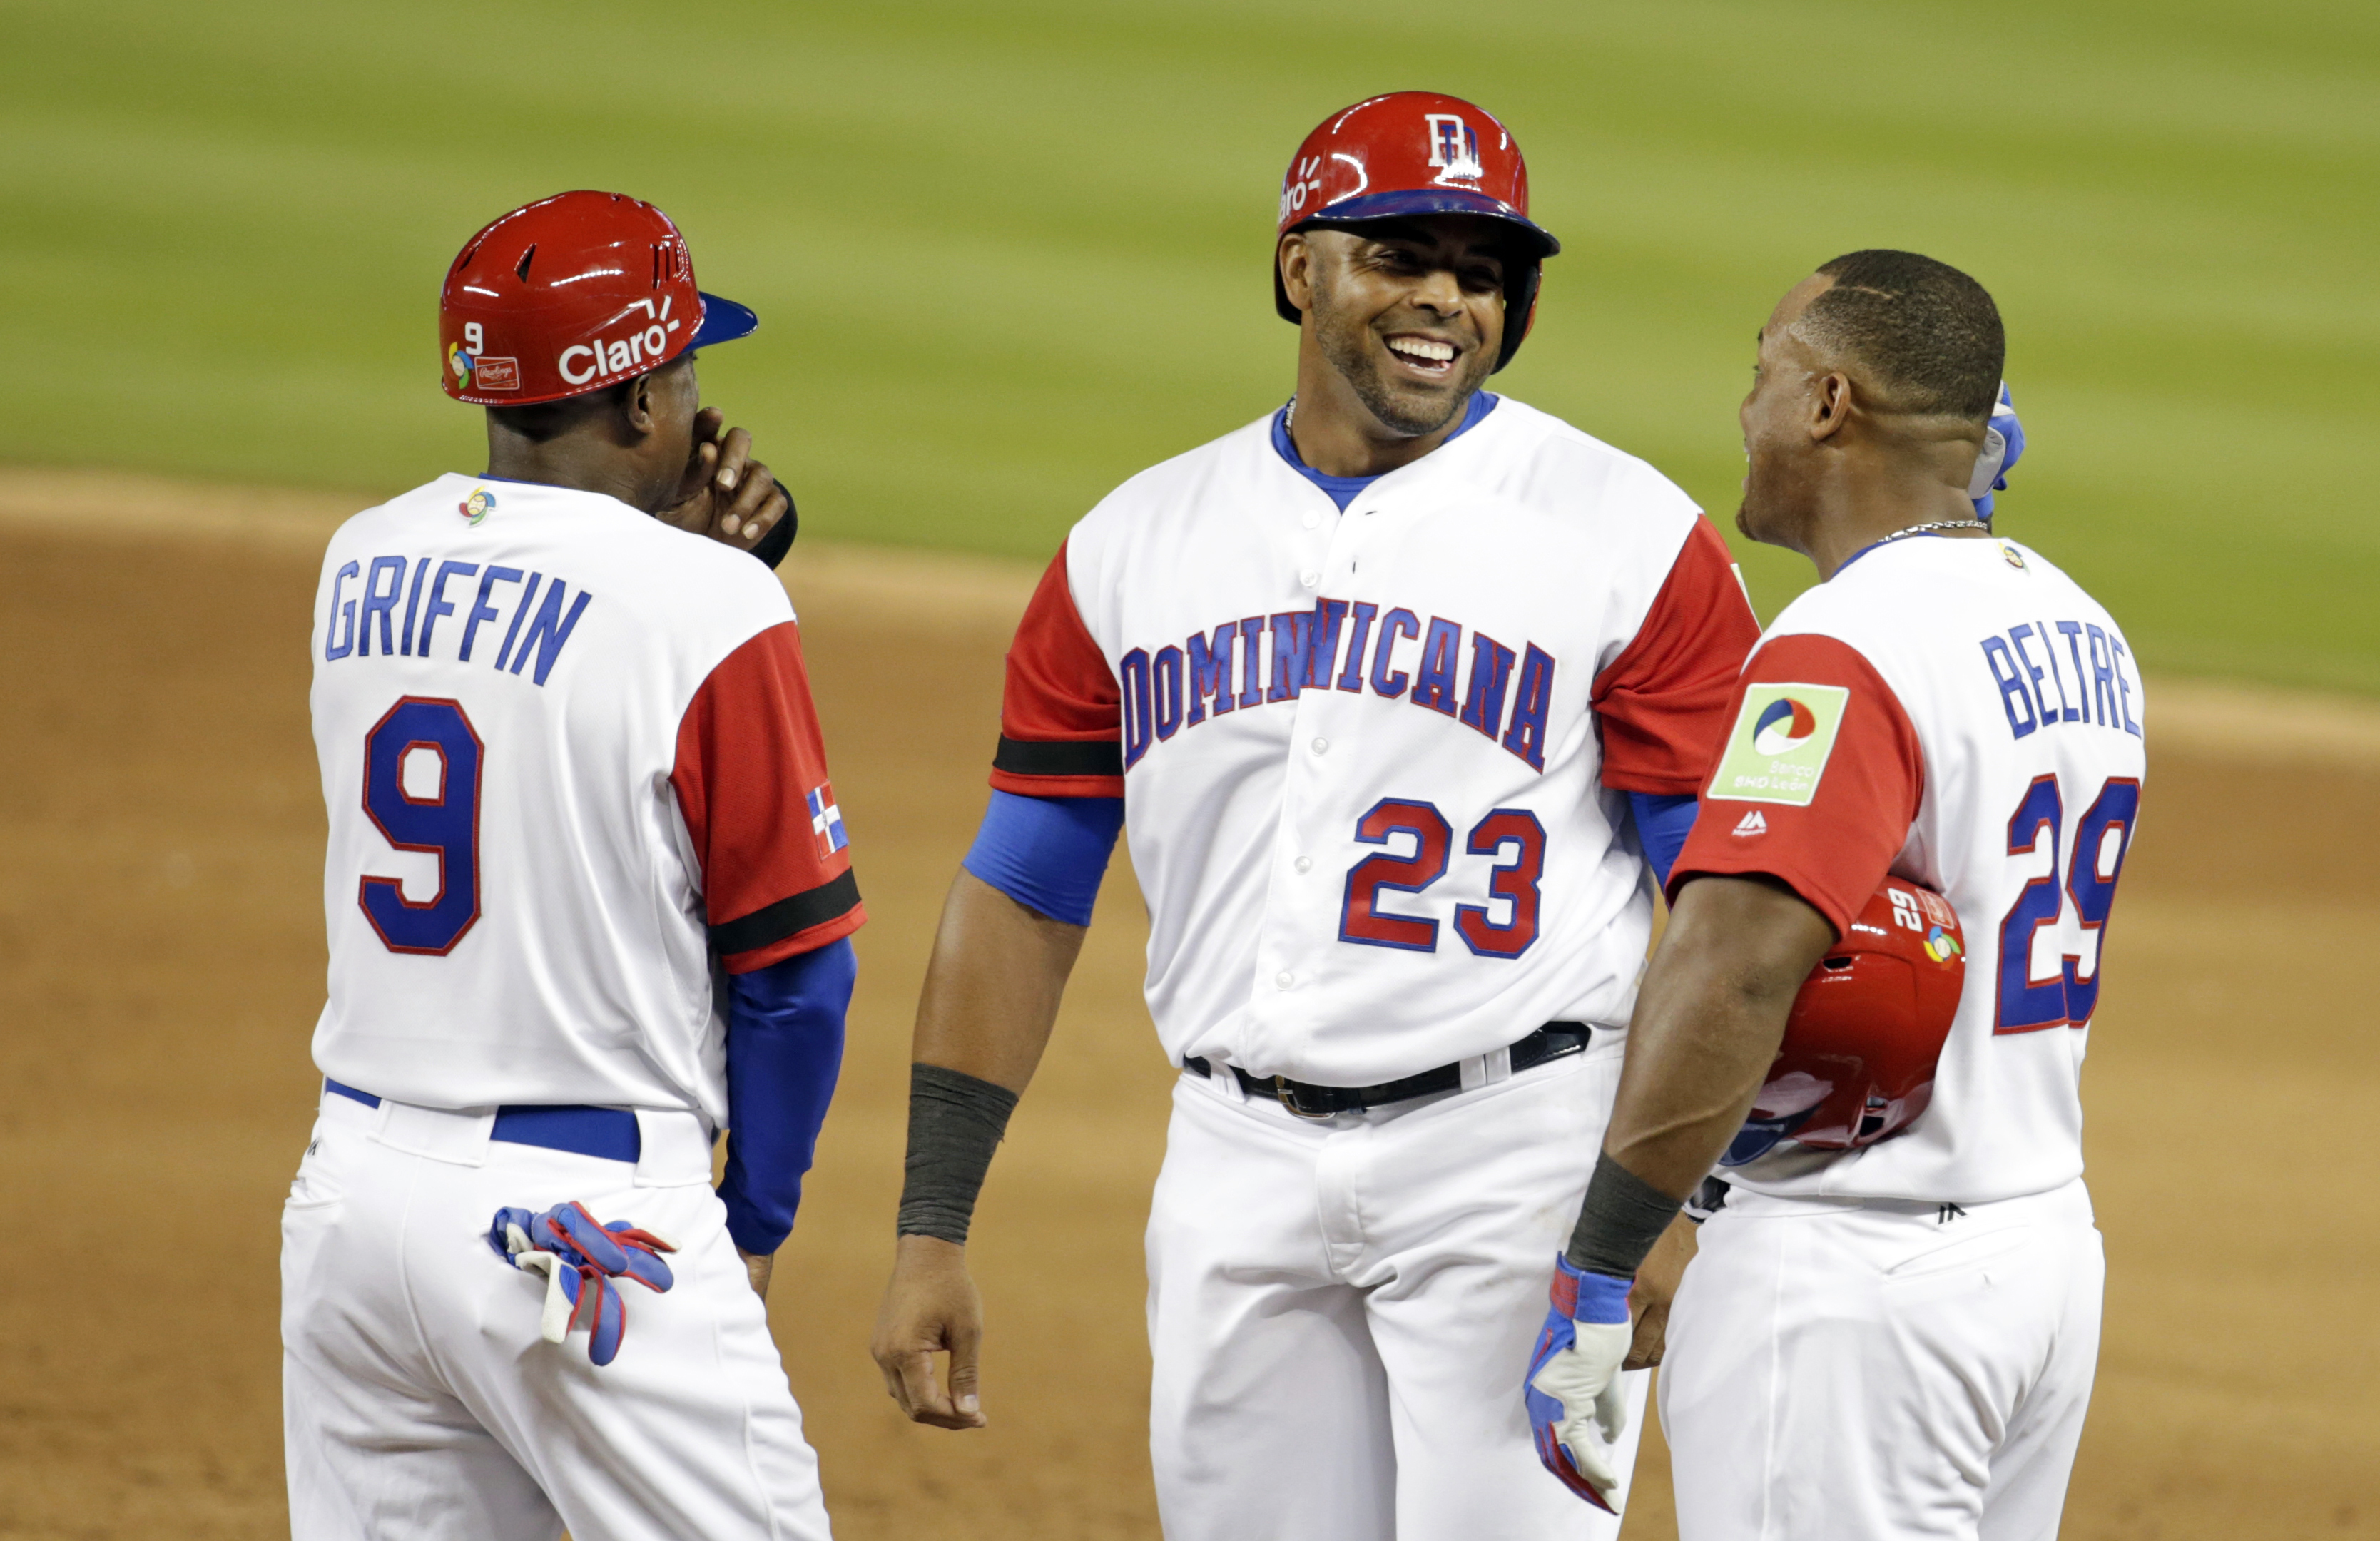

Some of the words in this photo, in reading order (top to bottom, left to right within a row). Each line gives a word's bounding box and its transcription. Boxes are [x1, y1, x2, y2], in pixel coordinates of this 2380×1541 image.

[464, 322, 484, 355] 9
[559, 324, 666, 385] Claro
[325, 555, 593, 687] GRIFFIN
[1980, 621, 2142, 741] BELTRE
[357, 694, 485, 957] 9
[1338, 796, 1547, 960] 23
[1887, 887, 1923, 932] 29
[1993, 772, 2140, 1036] 29
